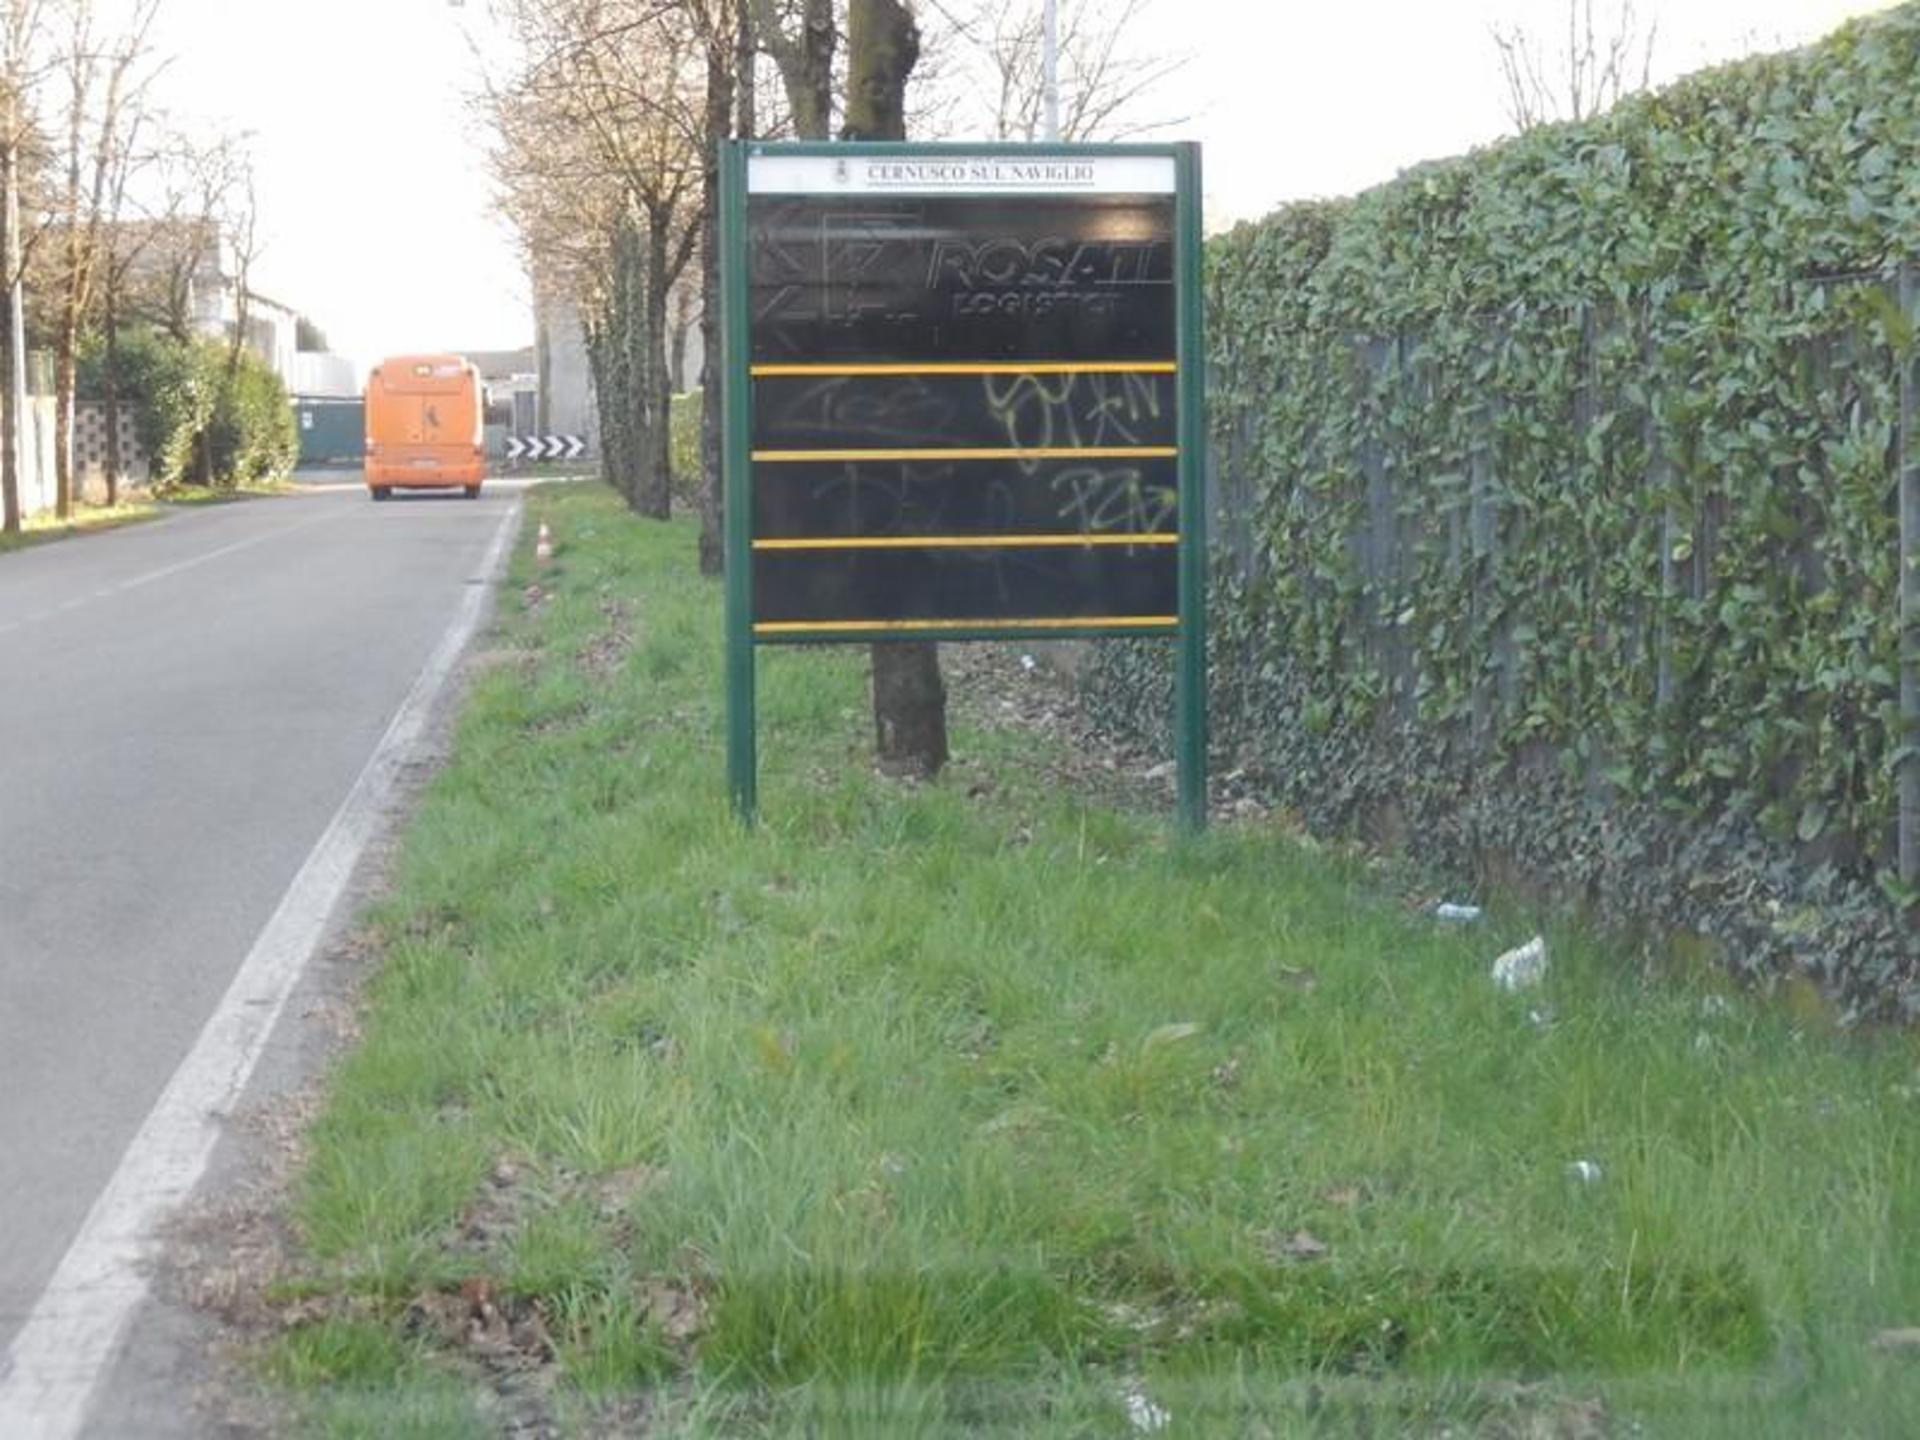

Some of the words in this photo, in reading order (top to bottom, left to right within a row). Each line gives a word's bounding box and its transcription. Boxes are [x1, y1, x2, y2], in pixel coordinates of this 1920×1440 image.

[867, 164, 966, 181] CERNUSCO
[970, 164, 1004, 181] SUL
[1012, 164, 1094, 181] NAVIGLIO
